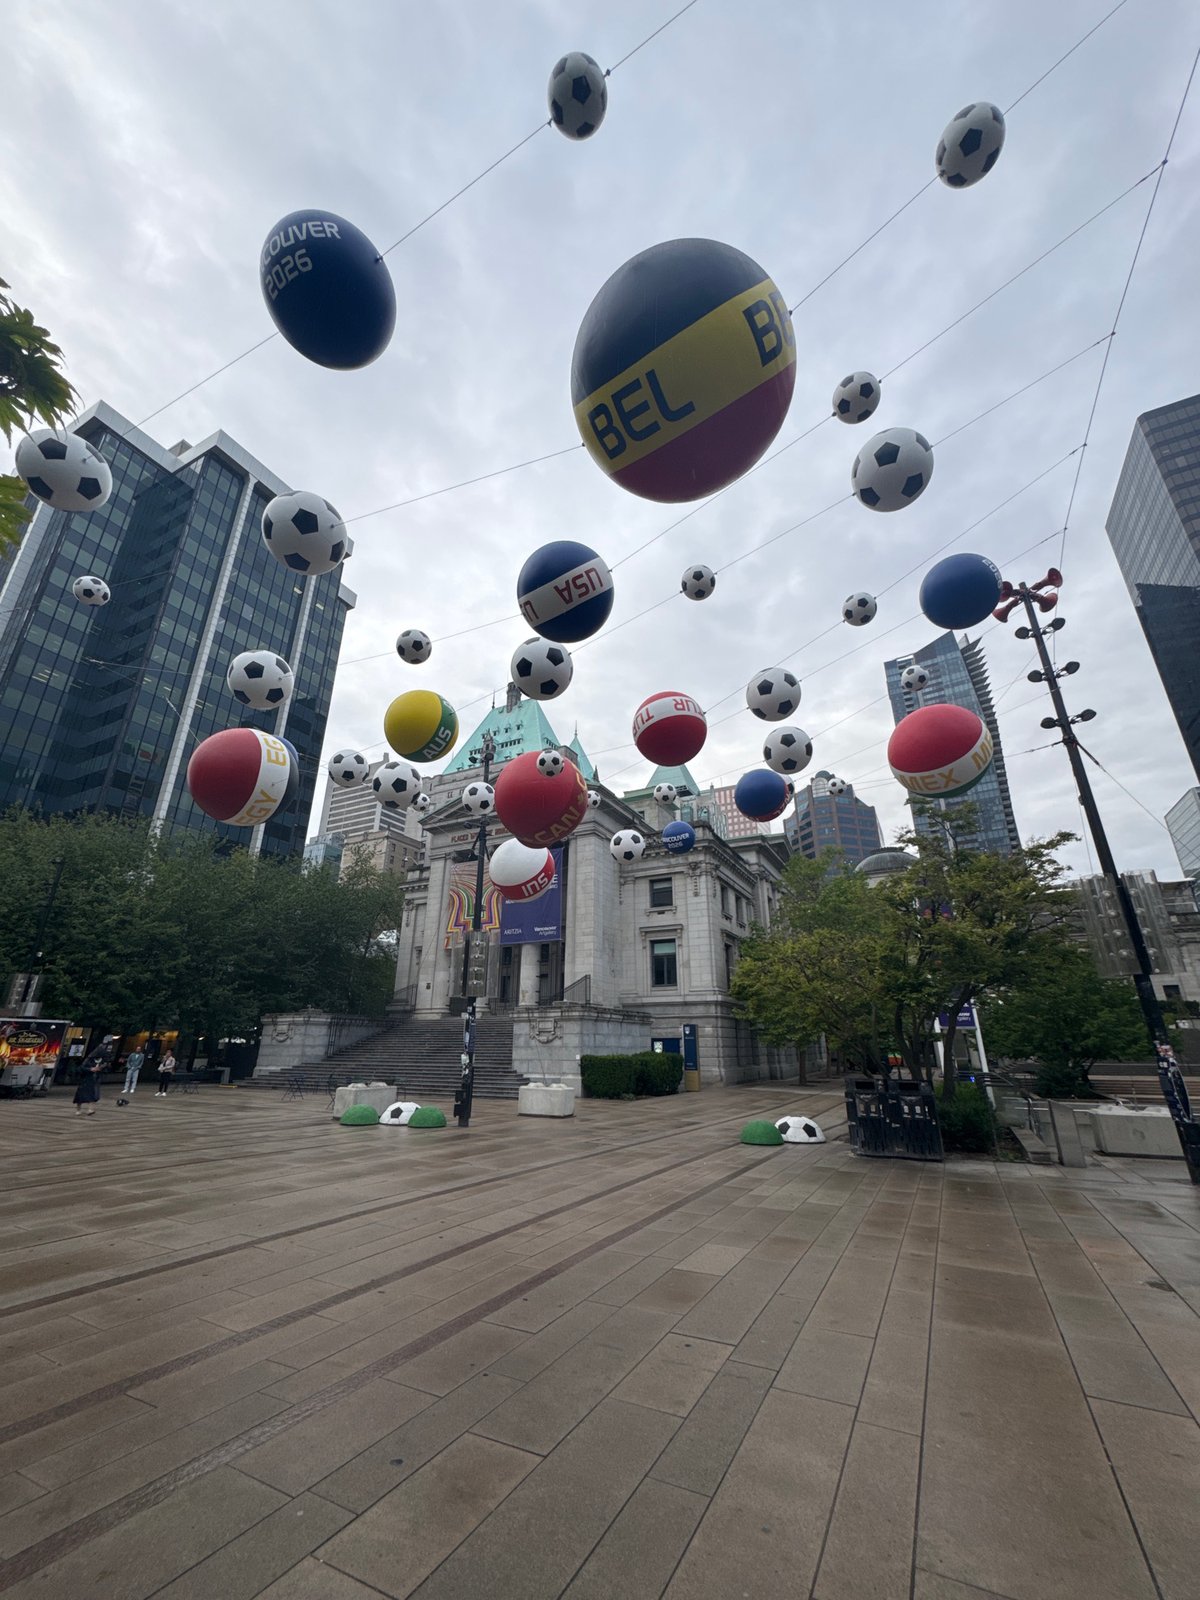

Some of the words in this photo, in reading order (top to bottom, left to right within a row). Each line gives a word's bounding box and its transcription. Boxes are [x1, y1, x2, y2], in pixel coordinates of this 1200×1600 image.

[265, 248, 313, 300] 2026
[588, 368, 696, 460] BEL
[553, 567, 604, 605] USA
[260, 733, 287, 767] EG
[422, 726, 452, 759] AUS
[898, 767, 961, 791] MEX
[234, 789, 278, 824] EGY
[534, 805, 581, 845] CAN
